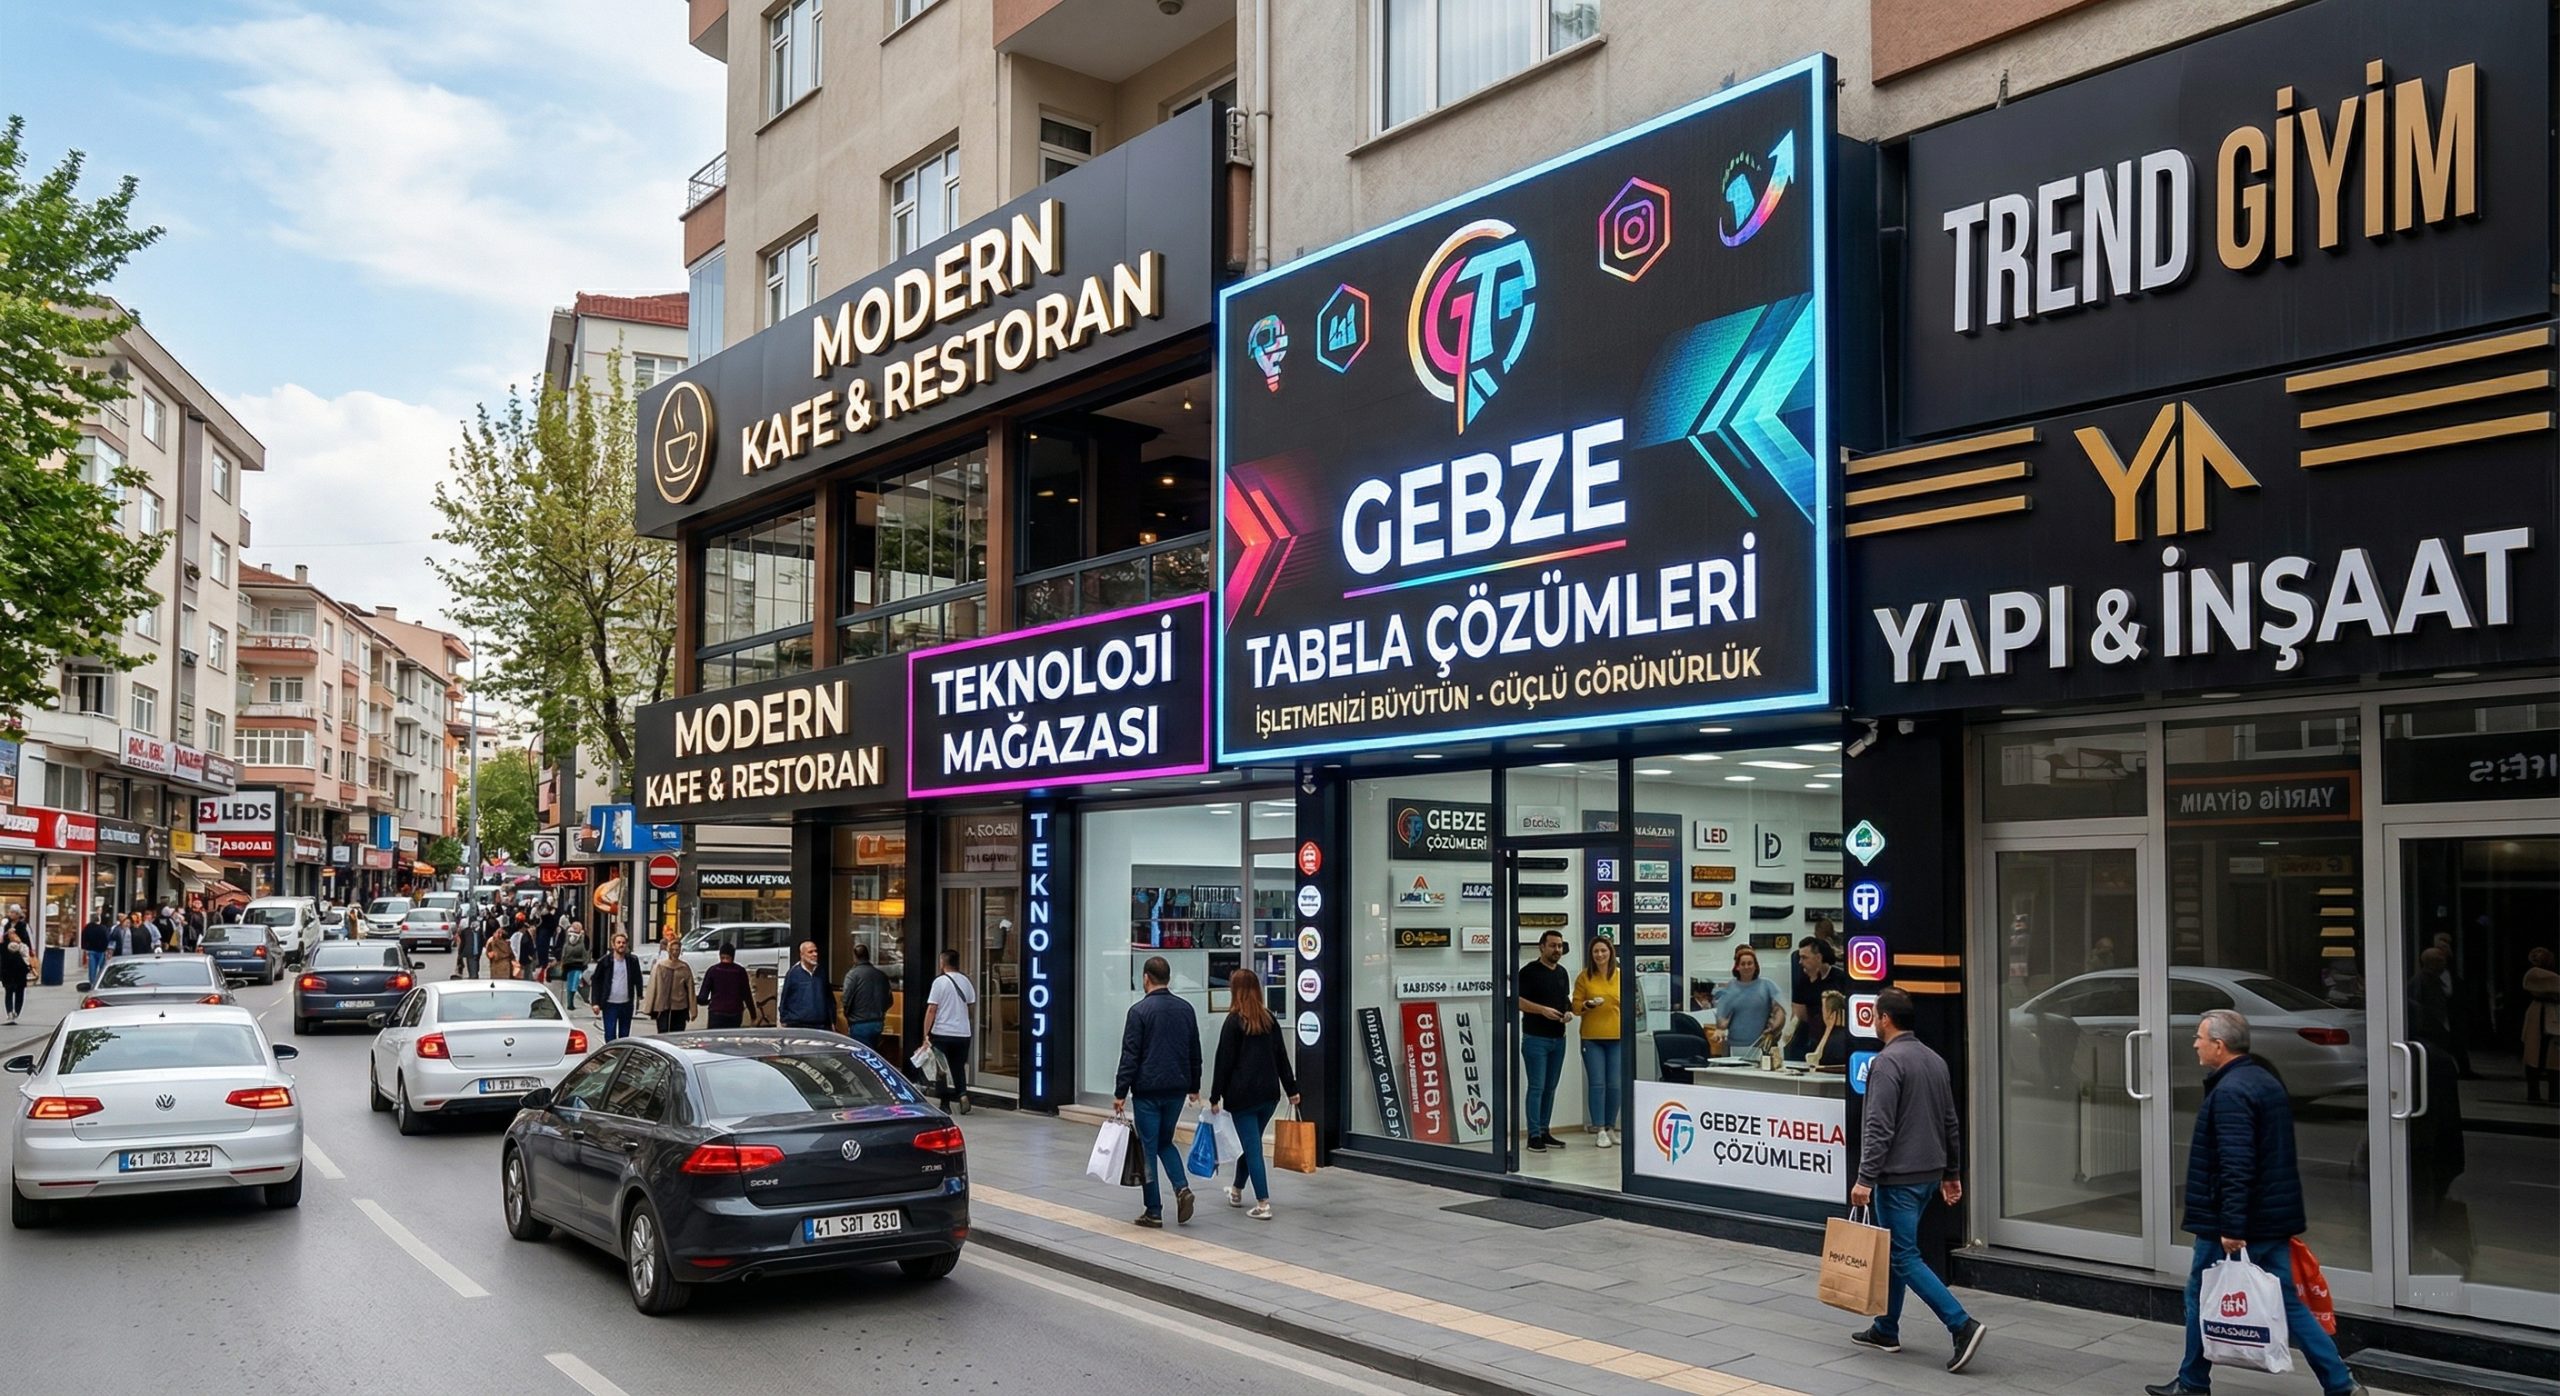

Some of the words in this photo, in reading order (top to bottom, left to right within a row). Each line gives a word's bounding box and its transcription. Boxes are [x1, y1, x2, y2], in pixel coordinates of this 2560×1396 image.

[1943, 149, 2194, 334] TREND
[2216, 59, 2480, 269] GİYİM
[812, 198, 1062, 379] MODERN
[741, 390, 840, 476] KAFE
[845, 378, 874, 434] &
[884, 250, 1163, 420] RESTORAN
[1341, 417, 1627, 575] GEBZE
[1246, 614, 1413, 689] TABELA
[1427, 532, 1758, 679] ÇÖZÜMLERİ
[1873, 585, 2073, 683] YAPI
[2090, 588, 2147, 663] &
[2162, 527, 2534, 671] İNŞAAT
[931, 614, 1174, 717] TEKNOLOJİ
[1255, 690, 1366, 740] İŞLETMENİZİ
[1371, 682, 1470, 721] BÜYÜTÜN
[1489, 671, 1568, 713] GÜÇLÜ
[1574, 643, 1762, 699] GÖRÜNÜRLÜK
[674, 680, 850, 759] MODERN
[942, 704, 1159, 776] MAĞAZASI
[222, 803, 272, 821] LEDS
[645, 768, 702, 807] KAFE
[708, 766, 726, 801] &
[732, 746, 886, 799] RESTORAN
[1426, 835, 1487, 853] ÇÖZÜMLERİ
[1427, 809, 1487, 832] GEBZE
[1704, 828, 1728, 843] LED
[129, 1153, 144, 1167] 41
[1700, 1111, 1761, 1136] GEBZE
[1767, 1117, 1846, 1147] TABELA
[1713, 1141, 1833, 1175] ÇÖZÜMLERİ
[815, 1219, 831, 1237] 41
